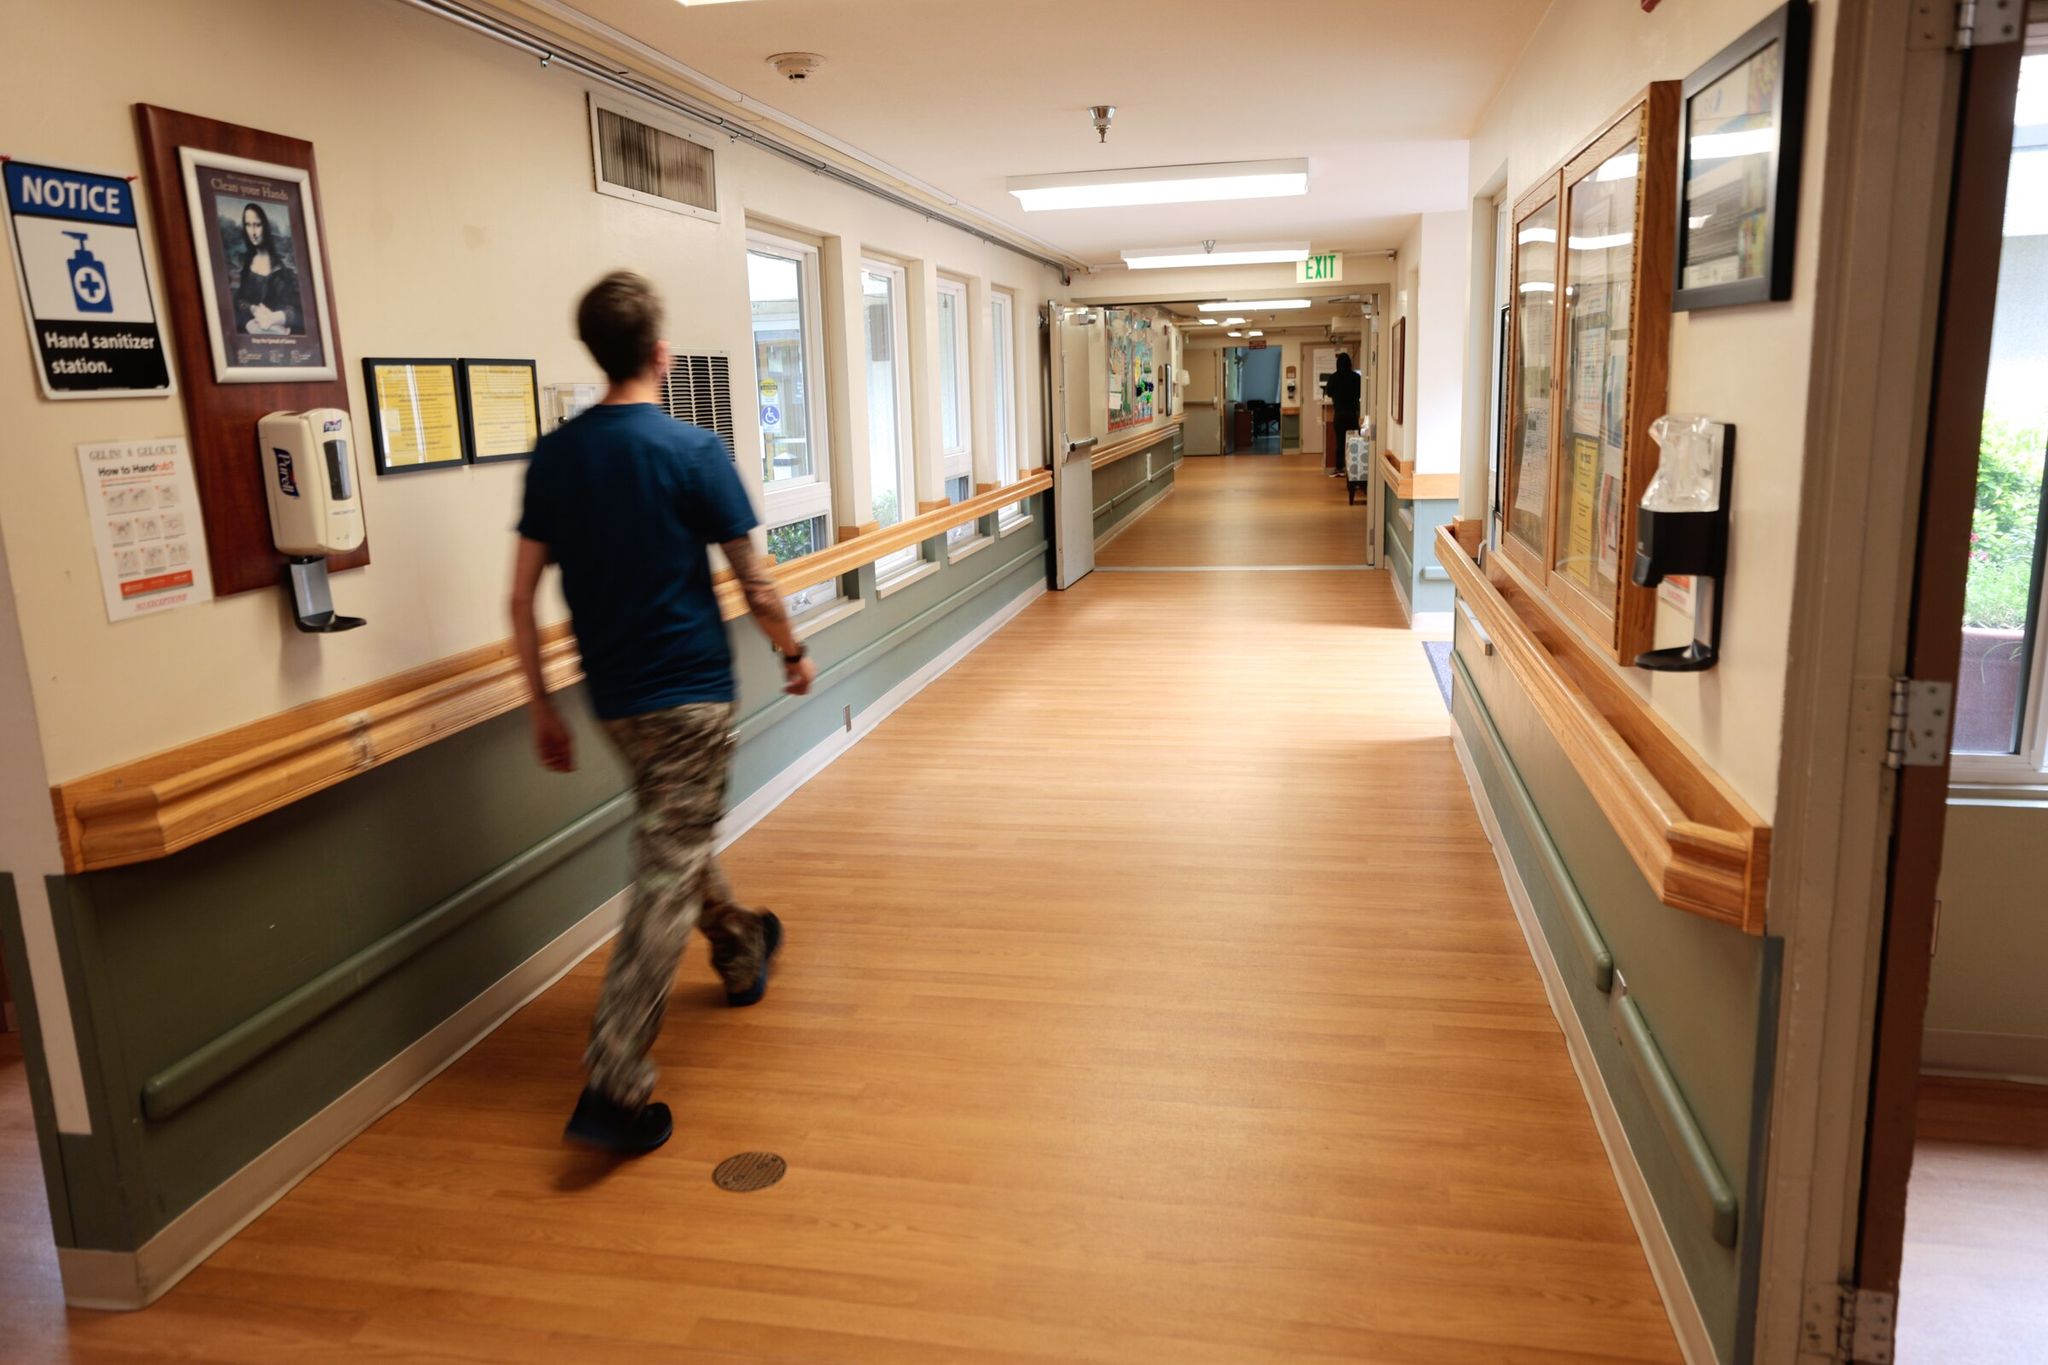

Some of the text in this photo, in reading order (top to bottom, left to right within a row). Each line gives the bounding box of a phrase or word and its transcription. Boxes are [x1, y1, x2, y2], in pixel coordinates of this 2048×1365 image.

[22, 175, 120, 214] NOTICE
[210, 178, 239, 193] Clean
[240, 185, 260, 197] your
[261, 186, 289, 201] Hands
[1305, 254, 1336, 279] EXIT
[44, 331, 155, 349] Hand sanitizer
[51, 357, 113, 374] station.
[98, 467, 119, 478] How
[121, 466, 130, 474] to
[278, 454, 295, 492] Purell
